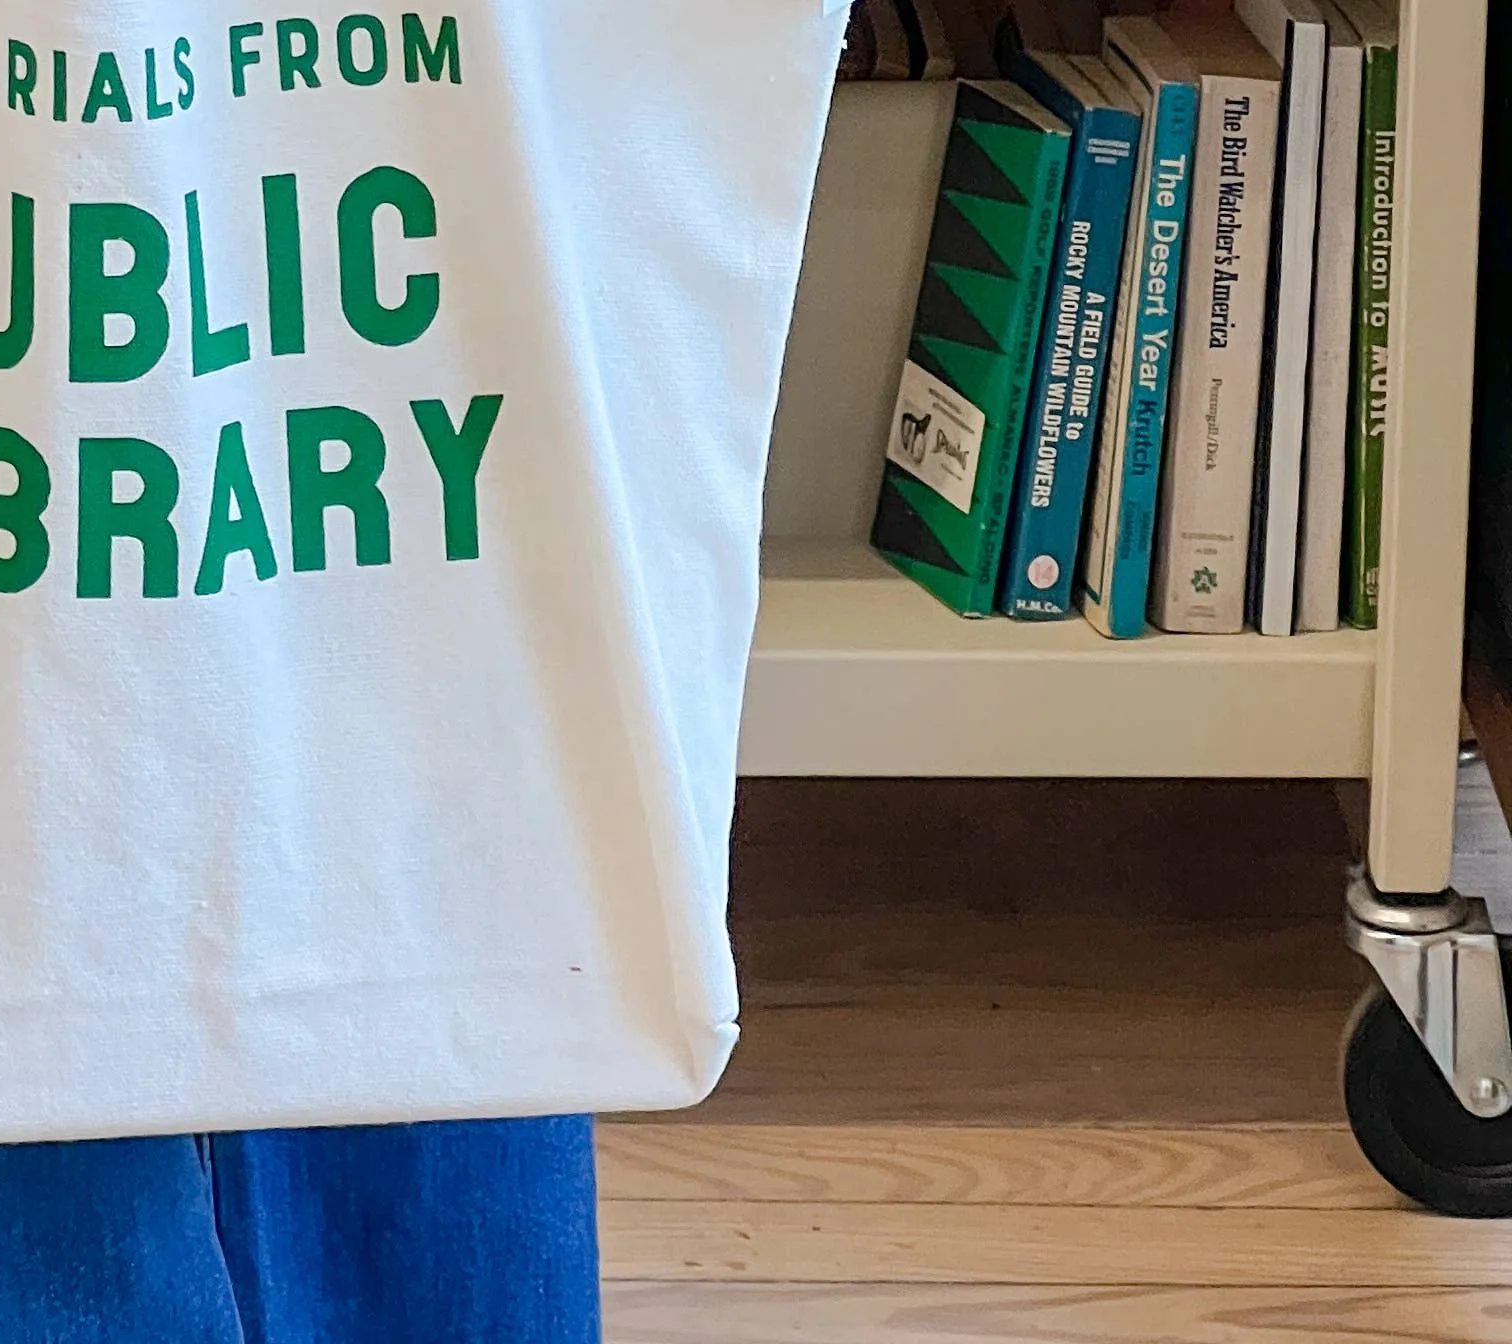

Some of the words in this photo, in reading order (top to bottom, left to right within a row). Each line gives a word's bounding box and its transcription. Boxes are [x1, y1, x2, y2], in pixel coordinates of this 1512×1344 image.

[228, 13, 463, 98] FROM
[1224, 96, 1251, 132] The
[1155, 153, 1186, 208] The
[1220, 135, 1248, 177] Bird
[1068, 220, 1091, 280] ROCKY
[1213, 178, 1245, 266] Watcher's
[1085, 289, 1095, 305] A
[1143, 220, 1180, 316] Desert
[1050, 282, 1083, 378] MOUNTAIN
[1080, 307, 1104, 360] FIELD
[1207, 267, 1240, 350] America
[1069, 362, 1095, 420] GUIDE
[1138, 329, 1170, 393] Year
[1030, 377, 1069, 509] WILDFLOWERS
[1065, 422, 1084, 442] to
[1130, 398, 1159, 476] Krutch
